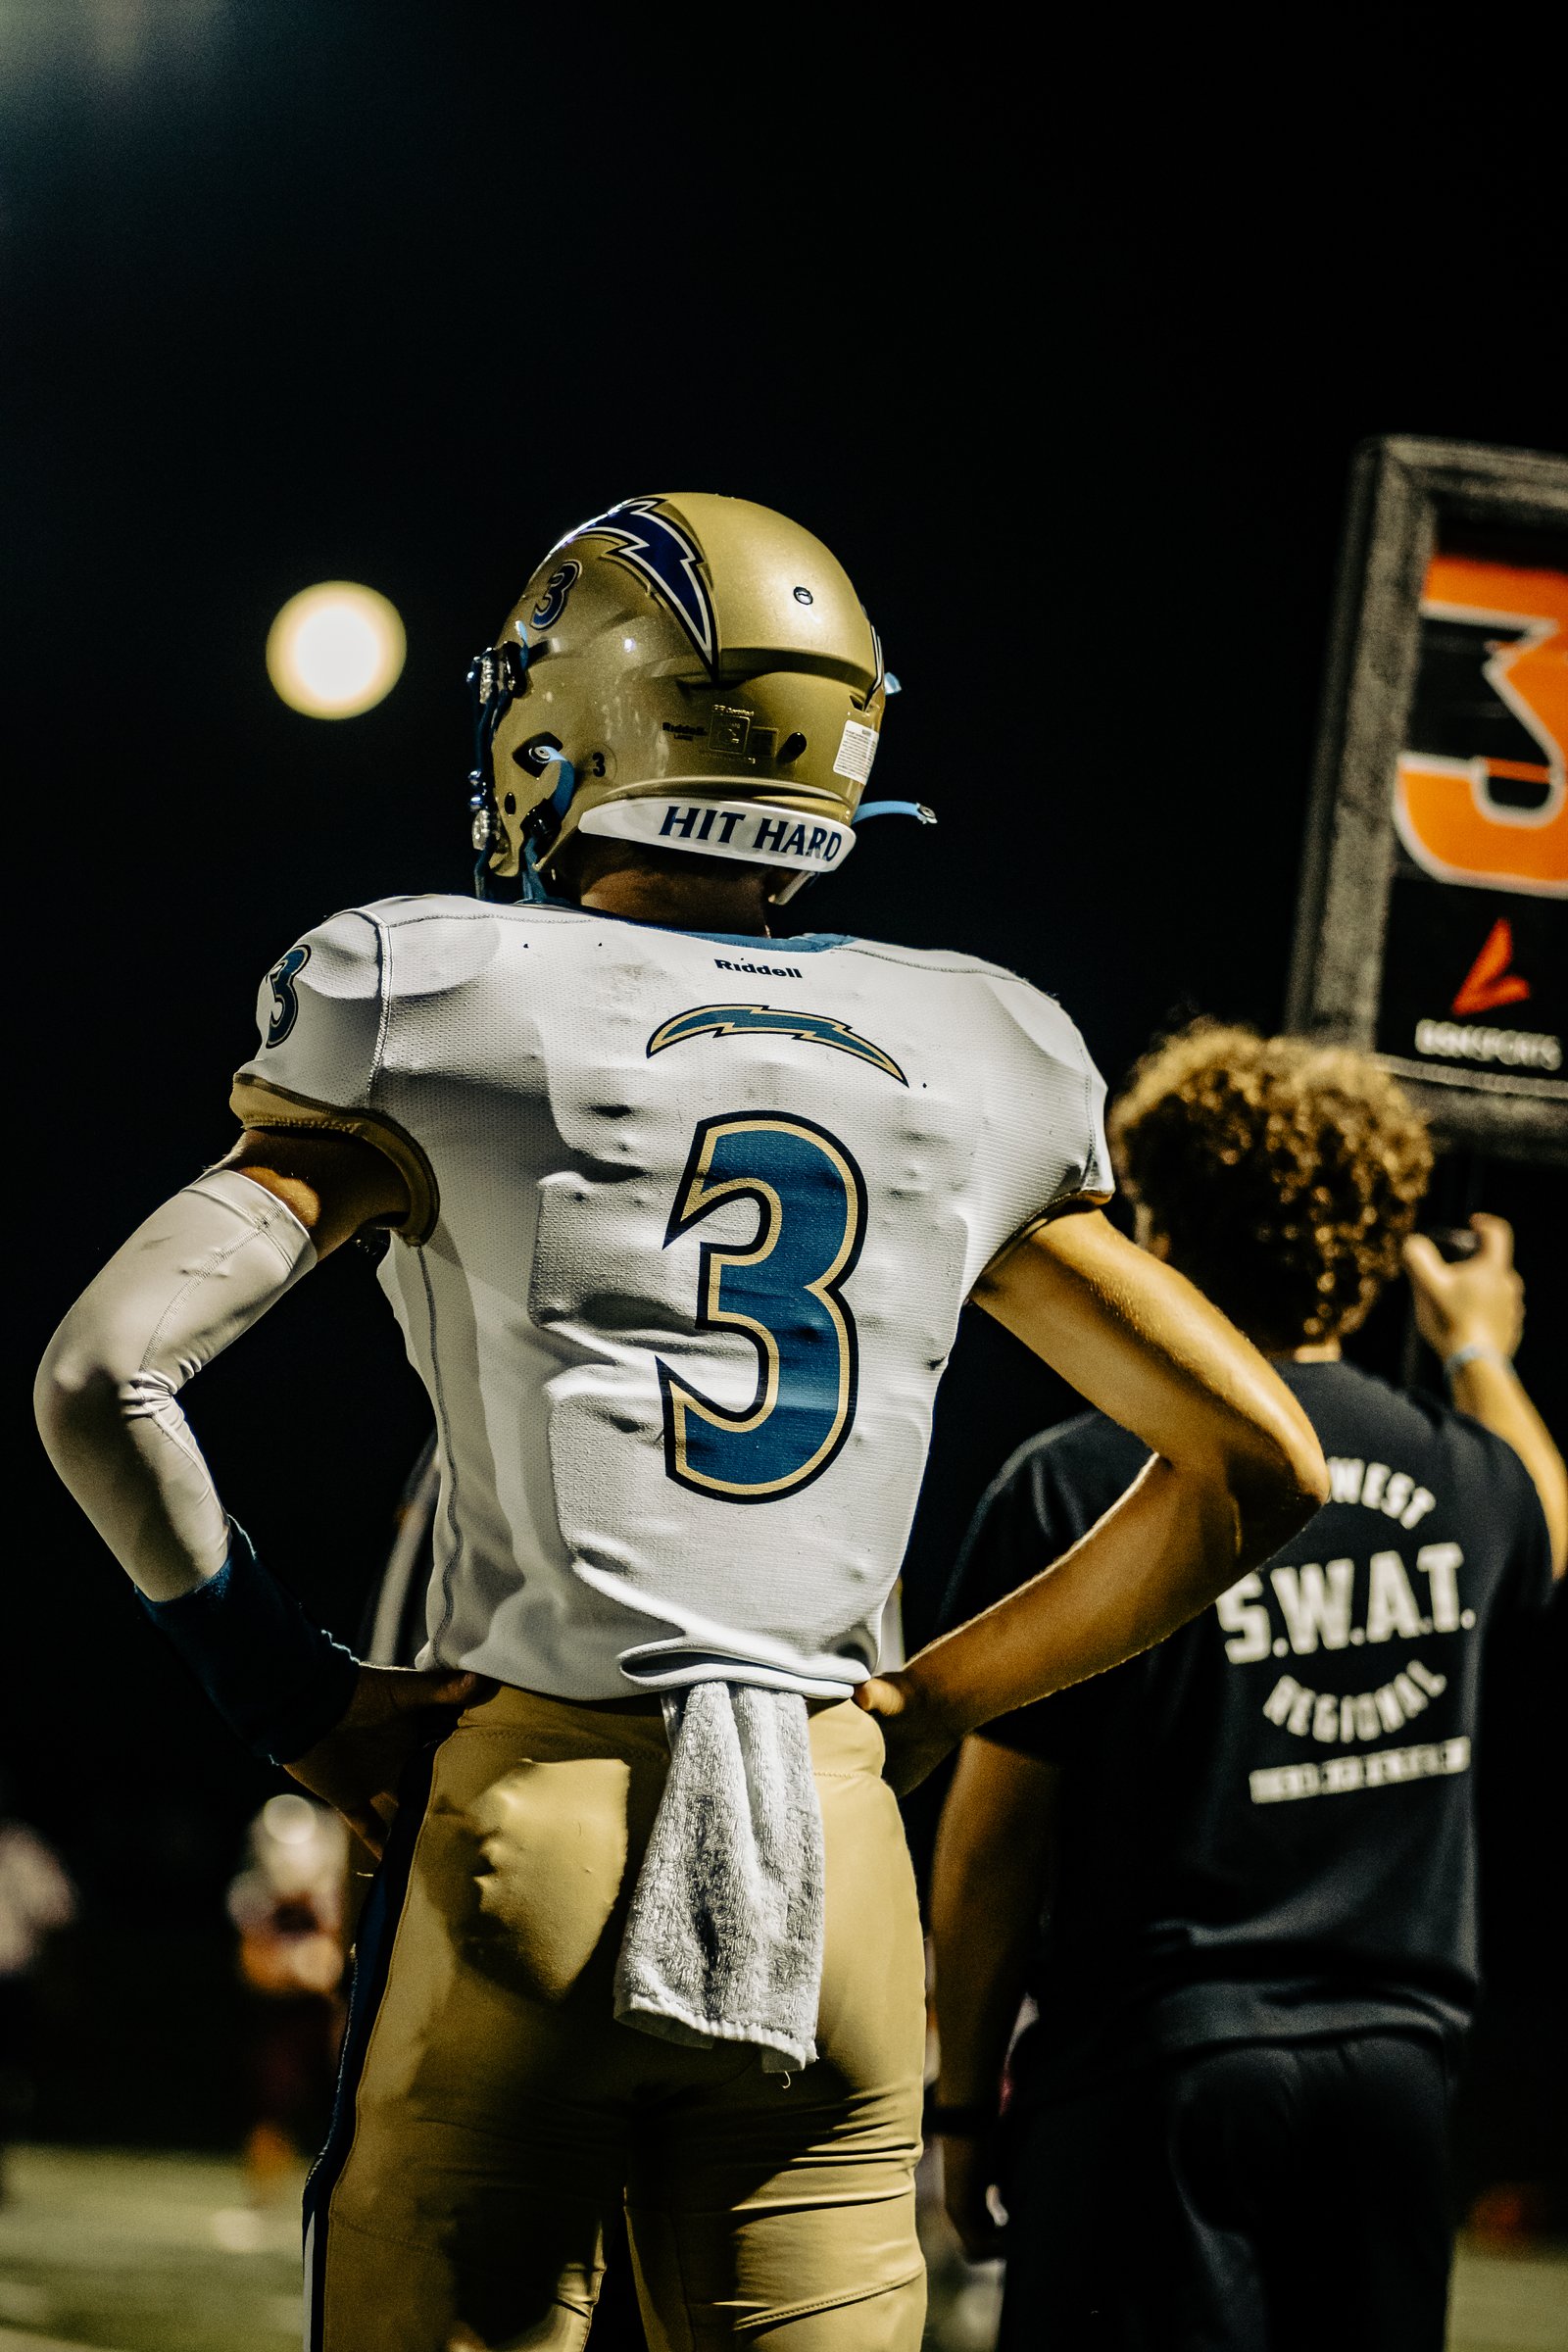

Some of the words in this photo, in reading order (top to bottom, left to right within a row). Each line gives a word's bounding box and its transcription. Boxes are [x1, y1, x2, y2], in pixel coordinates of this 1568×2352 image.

[530, 559, 582, 632] 3
[592, 752, 606, 777] 3
[1392, 555, 1568, 900] 3
[659, 806, 746, 844] HIT
[752, 817, 842, 861] HARD
[265, 944, 311, 1049] 3
[713, 958, 803, 979] Riddell
[655, 1109, 868, 1504] 3
[1323, 1455, 1437, 1530] WEST
[1215, 1542, 1477, 1665] S.W.A.T.
[1262, 1659, 1447, 1743] REGIONAL
